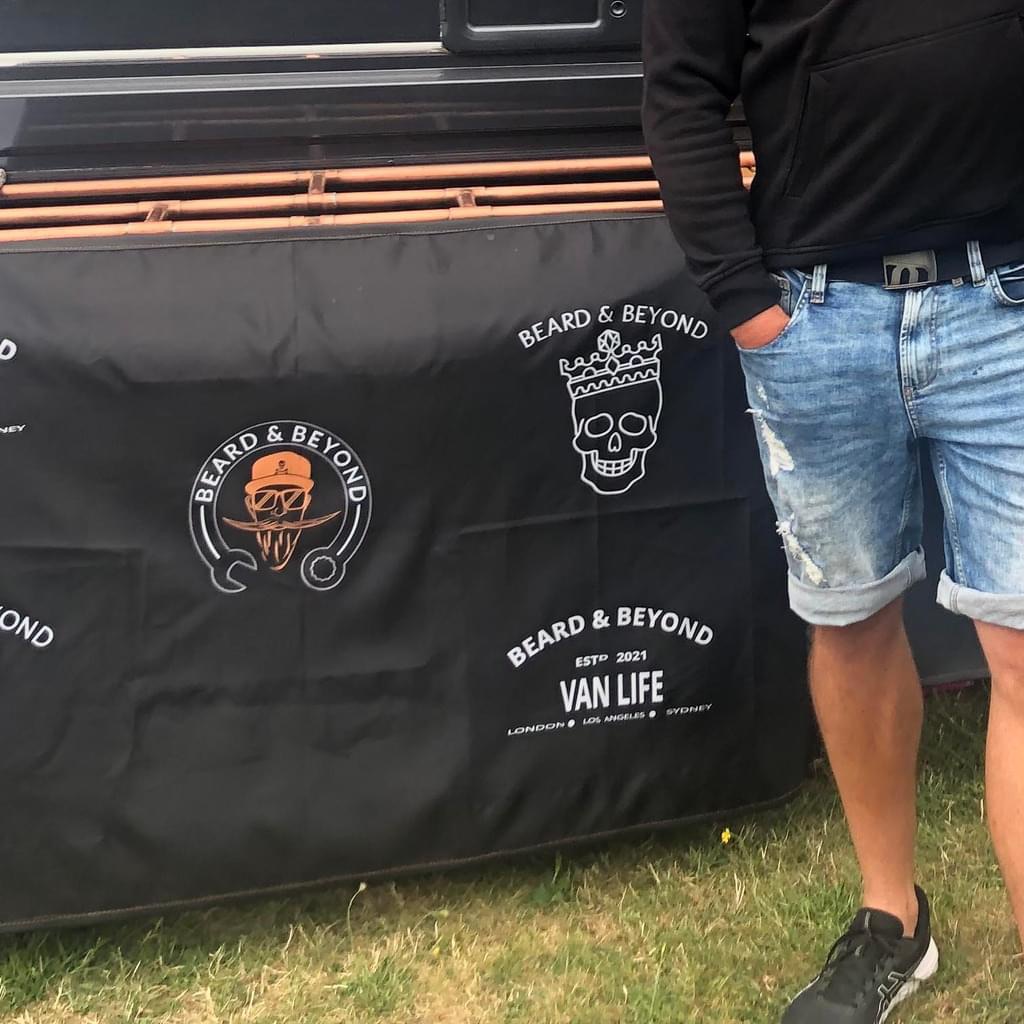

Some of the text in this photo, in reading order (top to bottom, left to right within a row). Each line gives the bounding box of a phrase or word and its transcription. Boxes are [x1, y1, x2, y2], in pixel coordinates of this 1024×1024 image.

[517, 304, 709, 349] BEARD & BEYOND
[194, 425, 368, 503] BEARD & BEYOND
[506, 606, 714, 668] BEARD & BEYOND
[575, 649, 648, 668] ESTD 2021
[559, 669, 664, 713] VAN LIFE
[507, 702, 713, 736] LONDON LOS ANGELES SYDNEY
